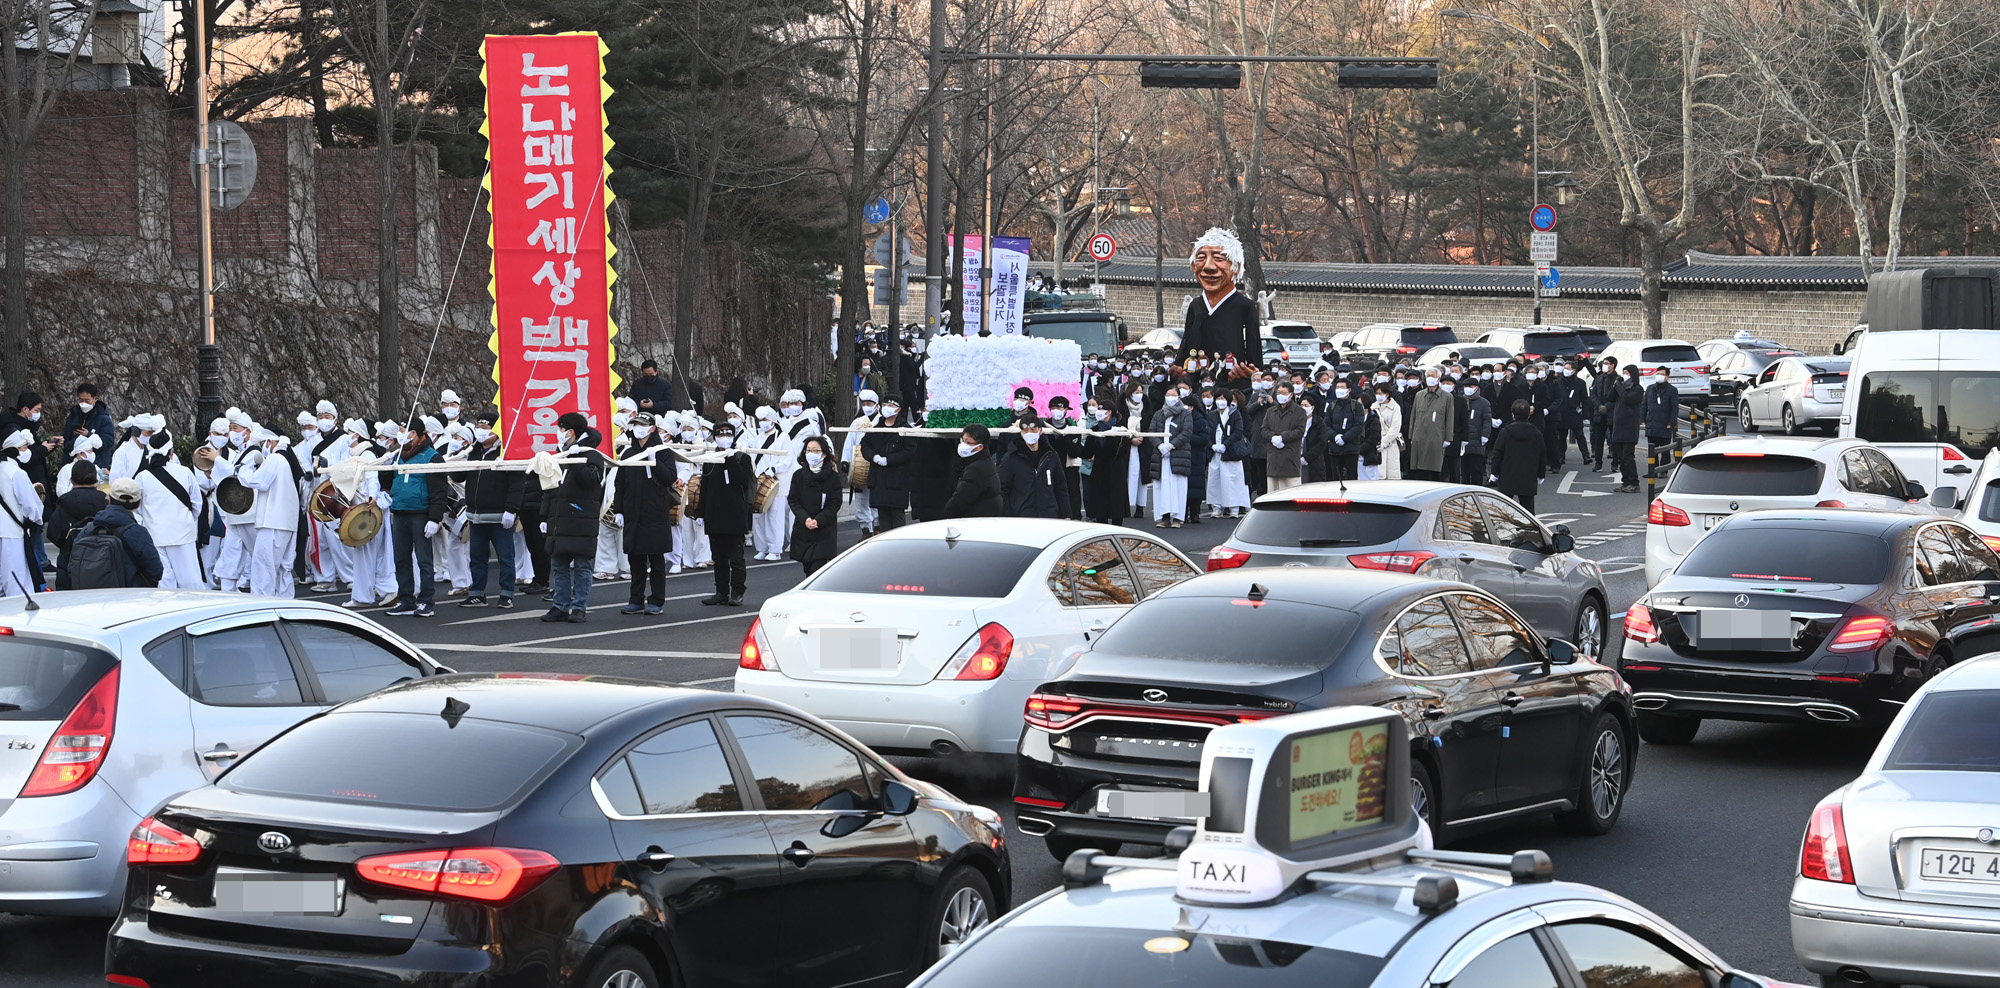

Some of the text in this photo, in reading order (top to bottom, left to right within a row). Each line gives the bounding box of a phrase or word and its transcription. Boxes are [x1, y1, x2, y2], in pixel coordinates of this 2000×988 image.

[521, 53, 576, 209] 노나메기
[1094, 241, 1110, 254] 50
[527, 217, 581, 306] 세상
[1263, 700, 1288, 709] hybrid
[1100, 735, 1197, 748] GRANDEU
[1291, 773, 1321, 792] BURGER
[1190, 861, 1245, 883] TAXI
[1936, 854, 1975, 875] 12다
